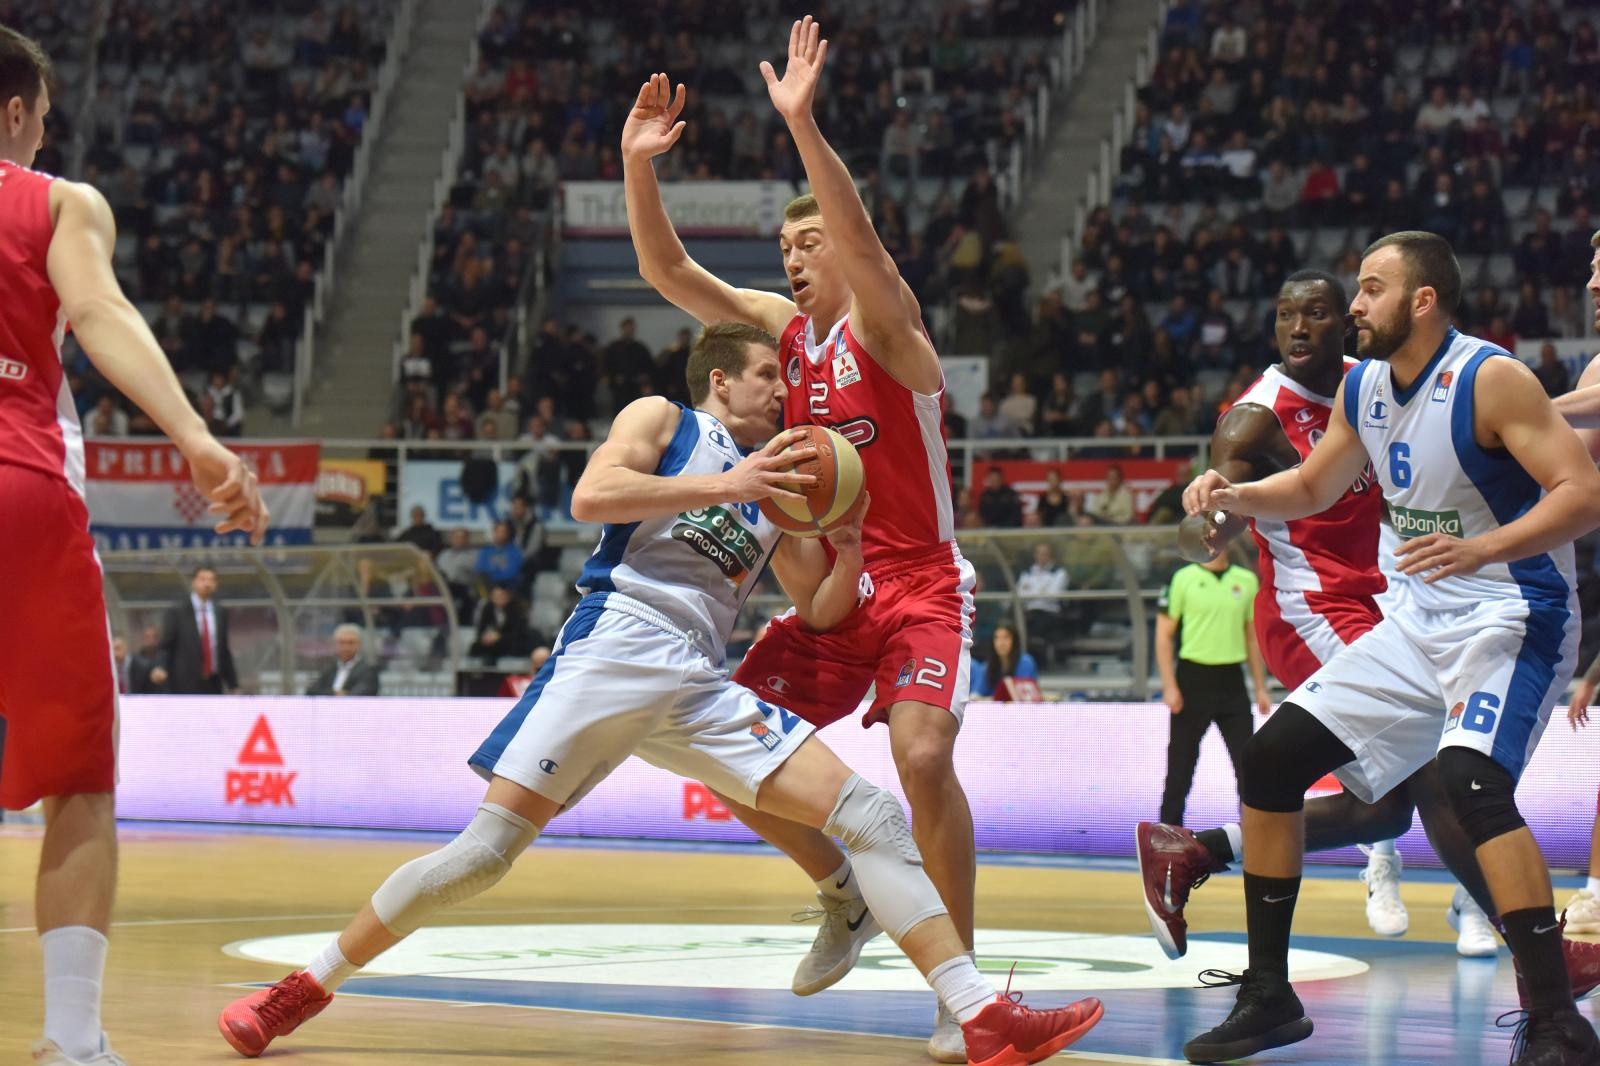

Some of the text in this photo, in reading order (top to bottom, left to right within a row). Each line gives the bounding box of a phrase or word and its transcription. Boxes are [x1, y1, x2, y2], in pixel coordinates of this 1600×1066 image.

[809, 381, 831, 415] 2
[1388, 441, 1412, 489] 6
[1391, 510, 1459, 534] tpbanka
[683, 529, 734, 571] CRODUX
[915, 656, 947, 690] 2
[1461, 691, 1500, 734] 6
[225, 771, 297, 806] PEAK
[683, 783, 734, 820] PE
